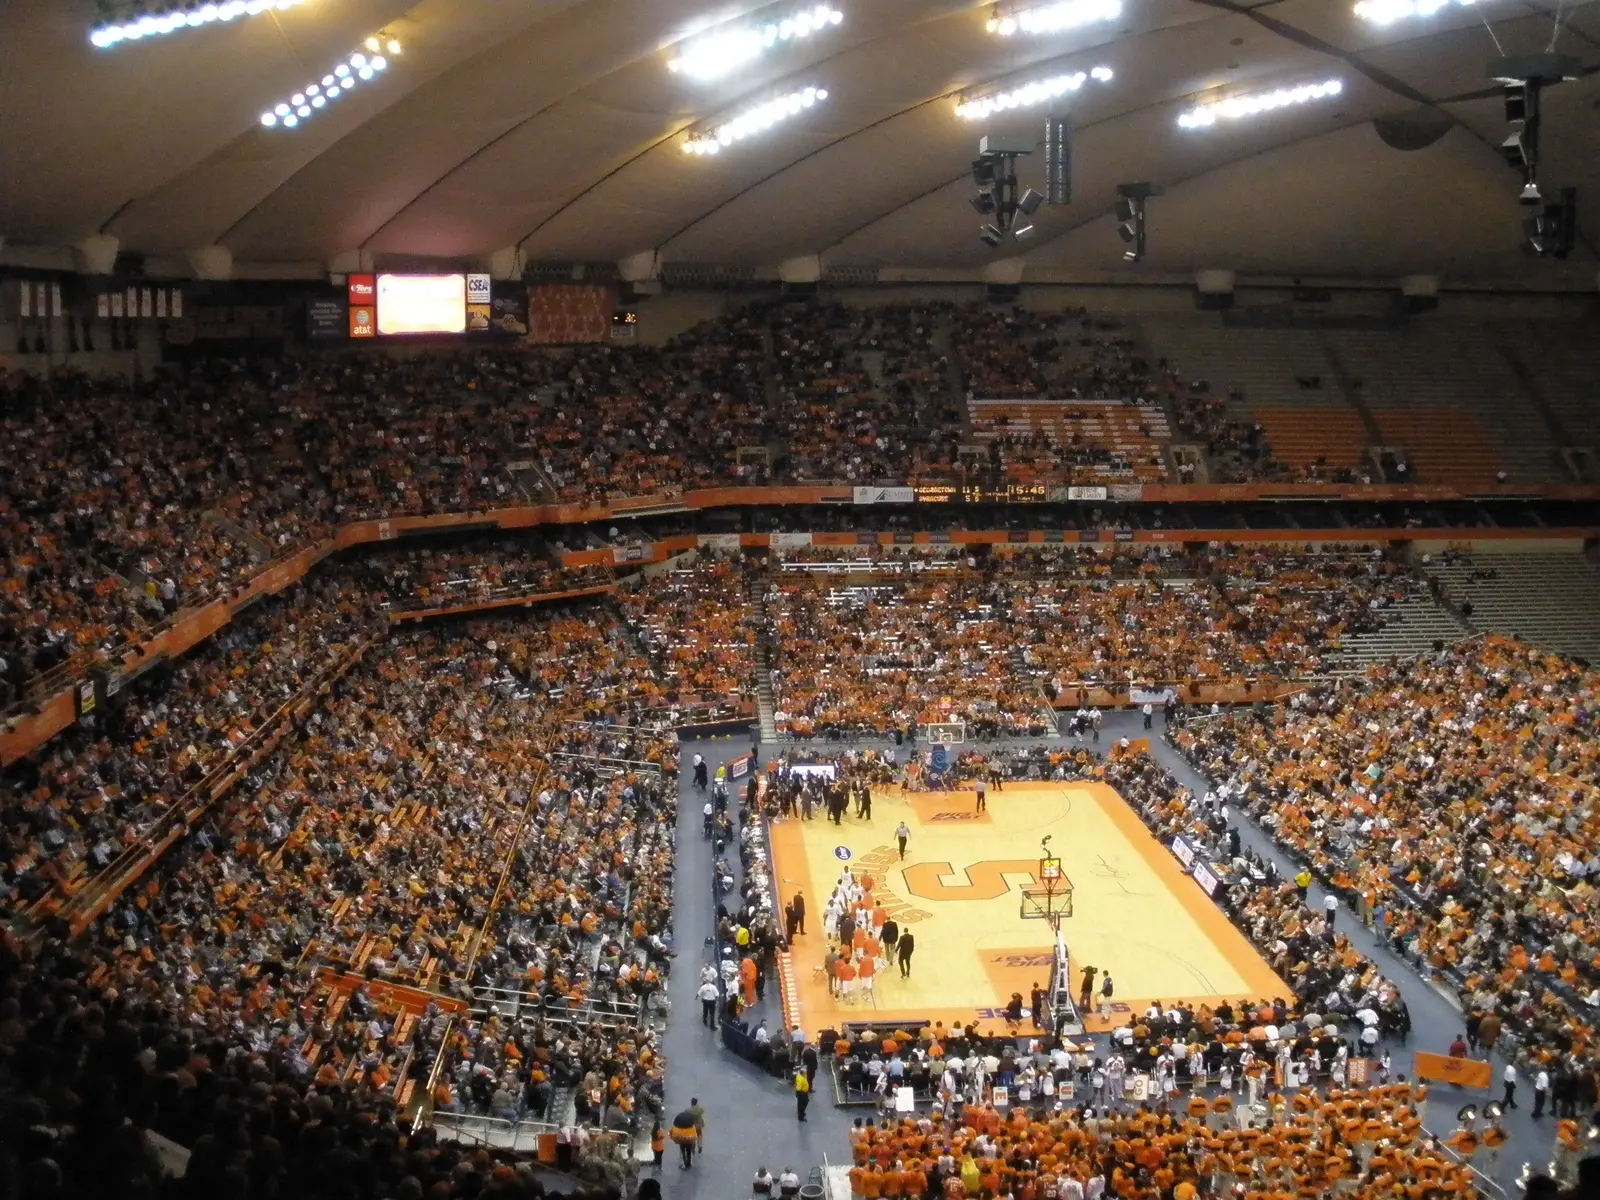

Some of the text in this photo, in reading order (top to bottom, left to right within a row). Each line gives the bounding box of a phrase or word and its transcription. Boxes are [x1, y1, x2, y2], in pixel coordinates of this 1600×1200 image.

[468, 279, 488, 292] CSEA
[353, 325, 371, 335] at&t
[1134, 1079, 1144, 1096] GO
